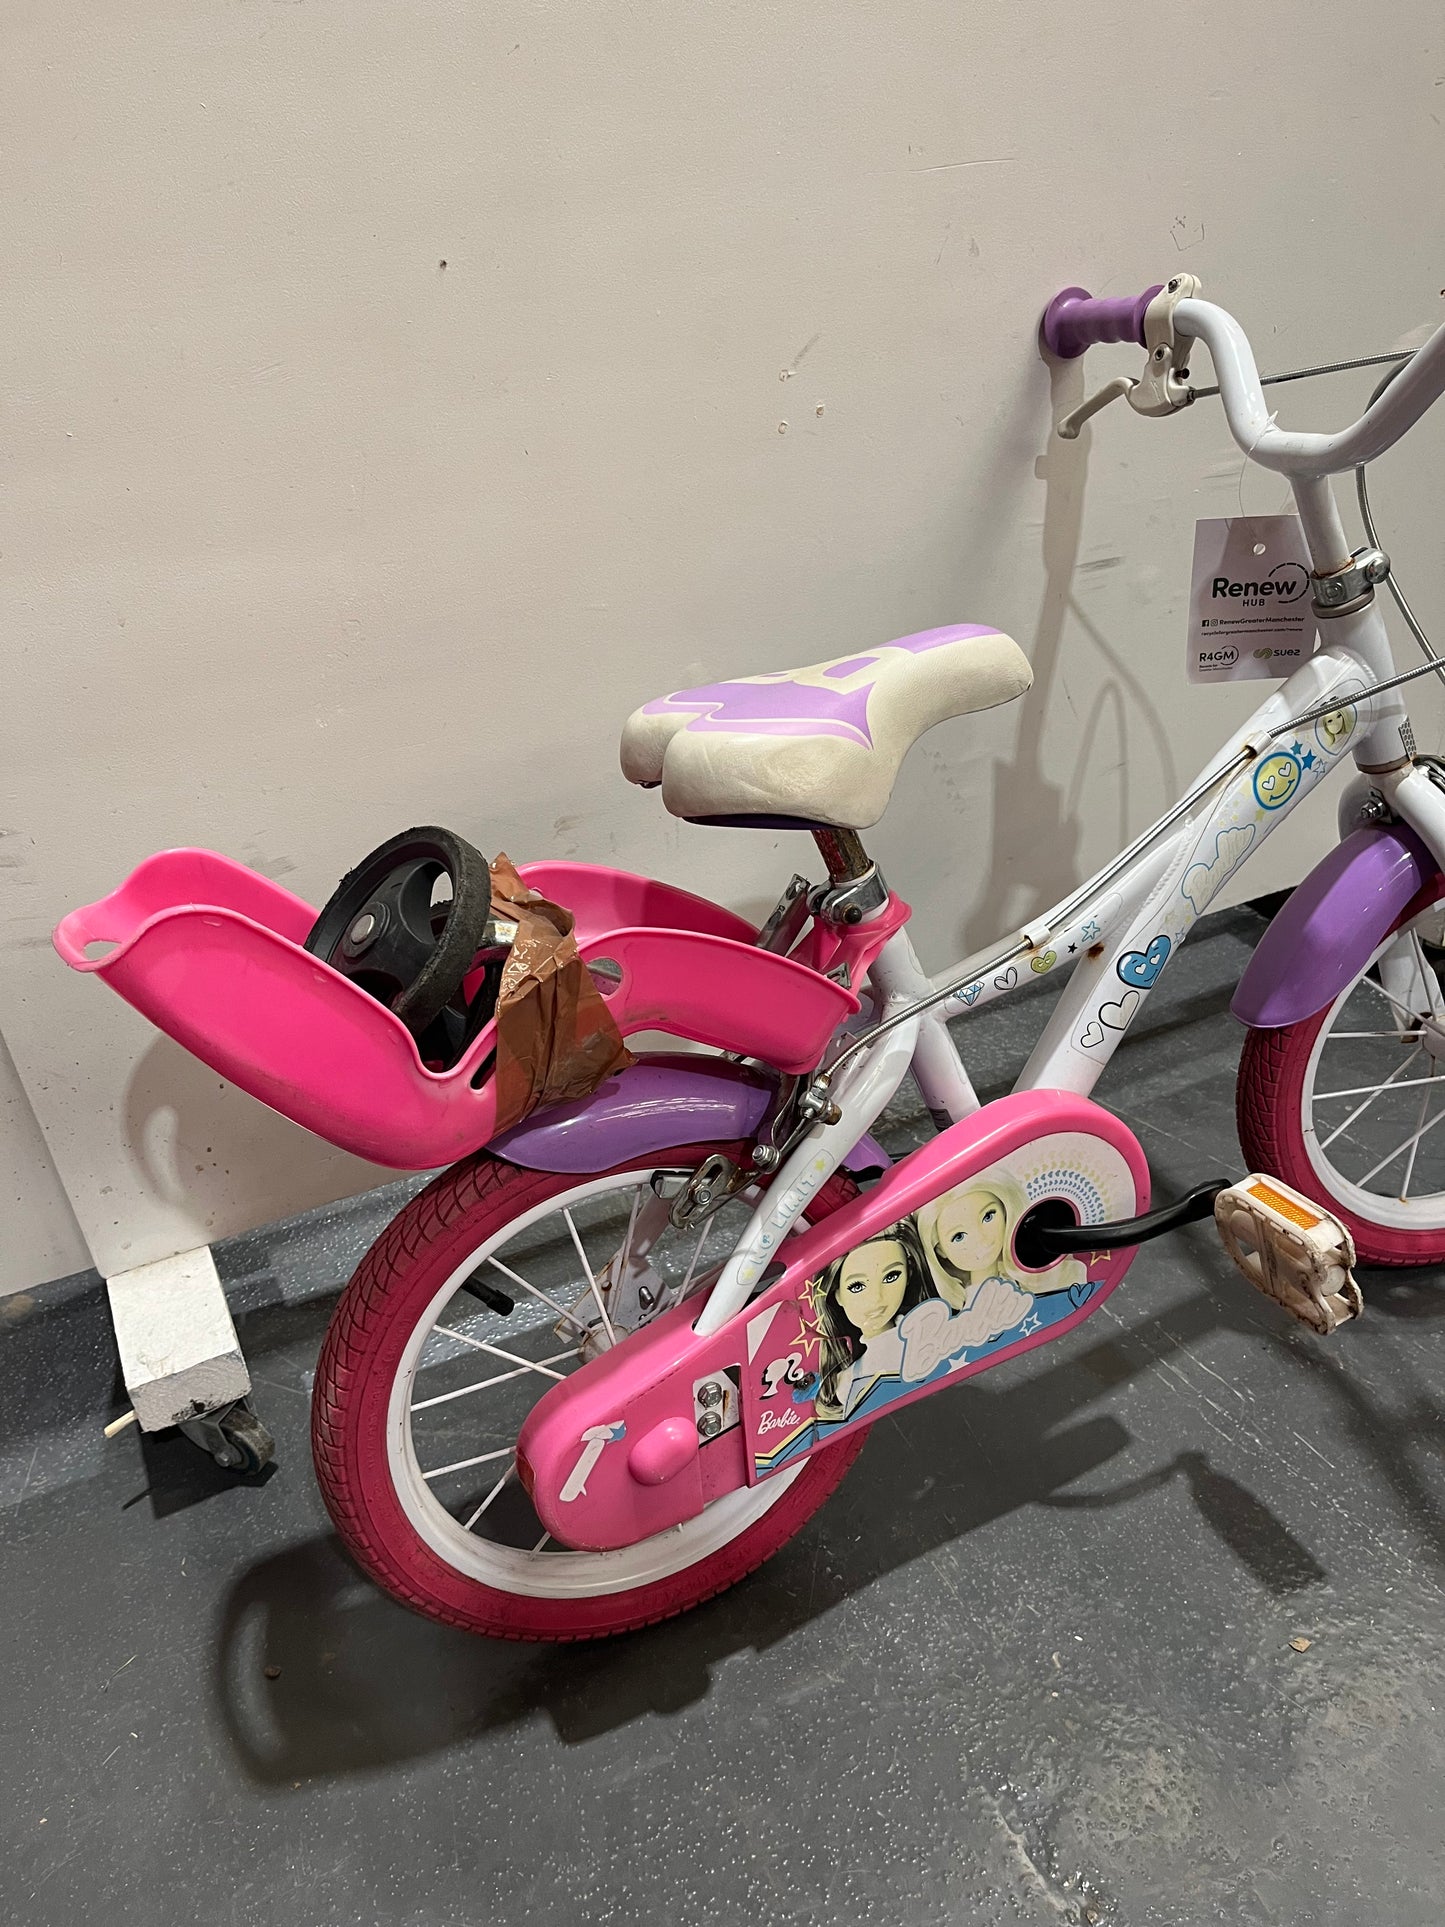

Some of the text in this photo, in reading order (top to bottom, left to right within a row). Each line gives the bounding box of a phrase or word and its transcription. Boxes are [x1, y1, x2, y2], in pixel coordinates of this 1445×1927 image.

[1212, 577, 1297, 598] Renew
[1242, 598, 1266, 607] HUB
[1220, 616, 1305, 626] RenewGreaterManchester
[1199, 650, 1234, 662] R4GM
[757, 1407, 801, 1435] Barbie
